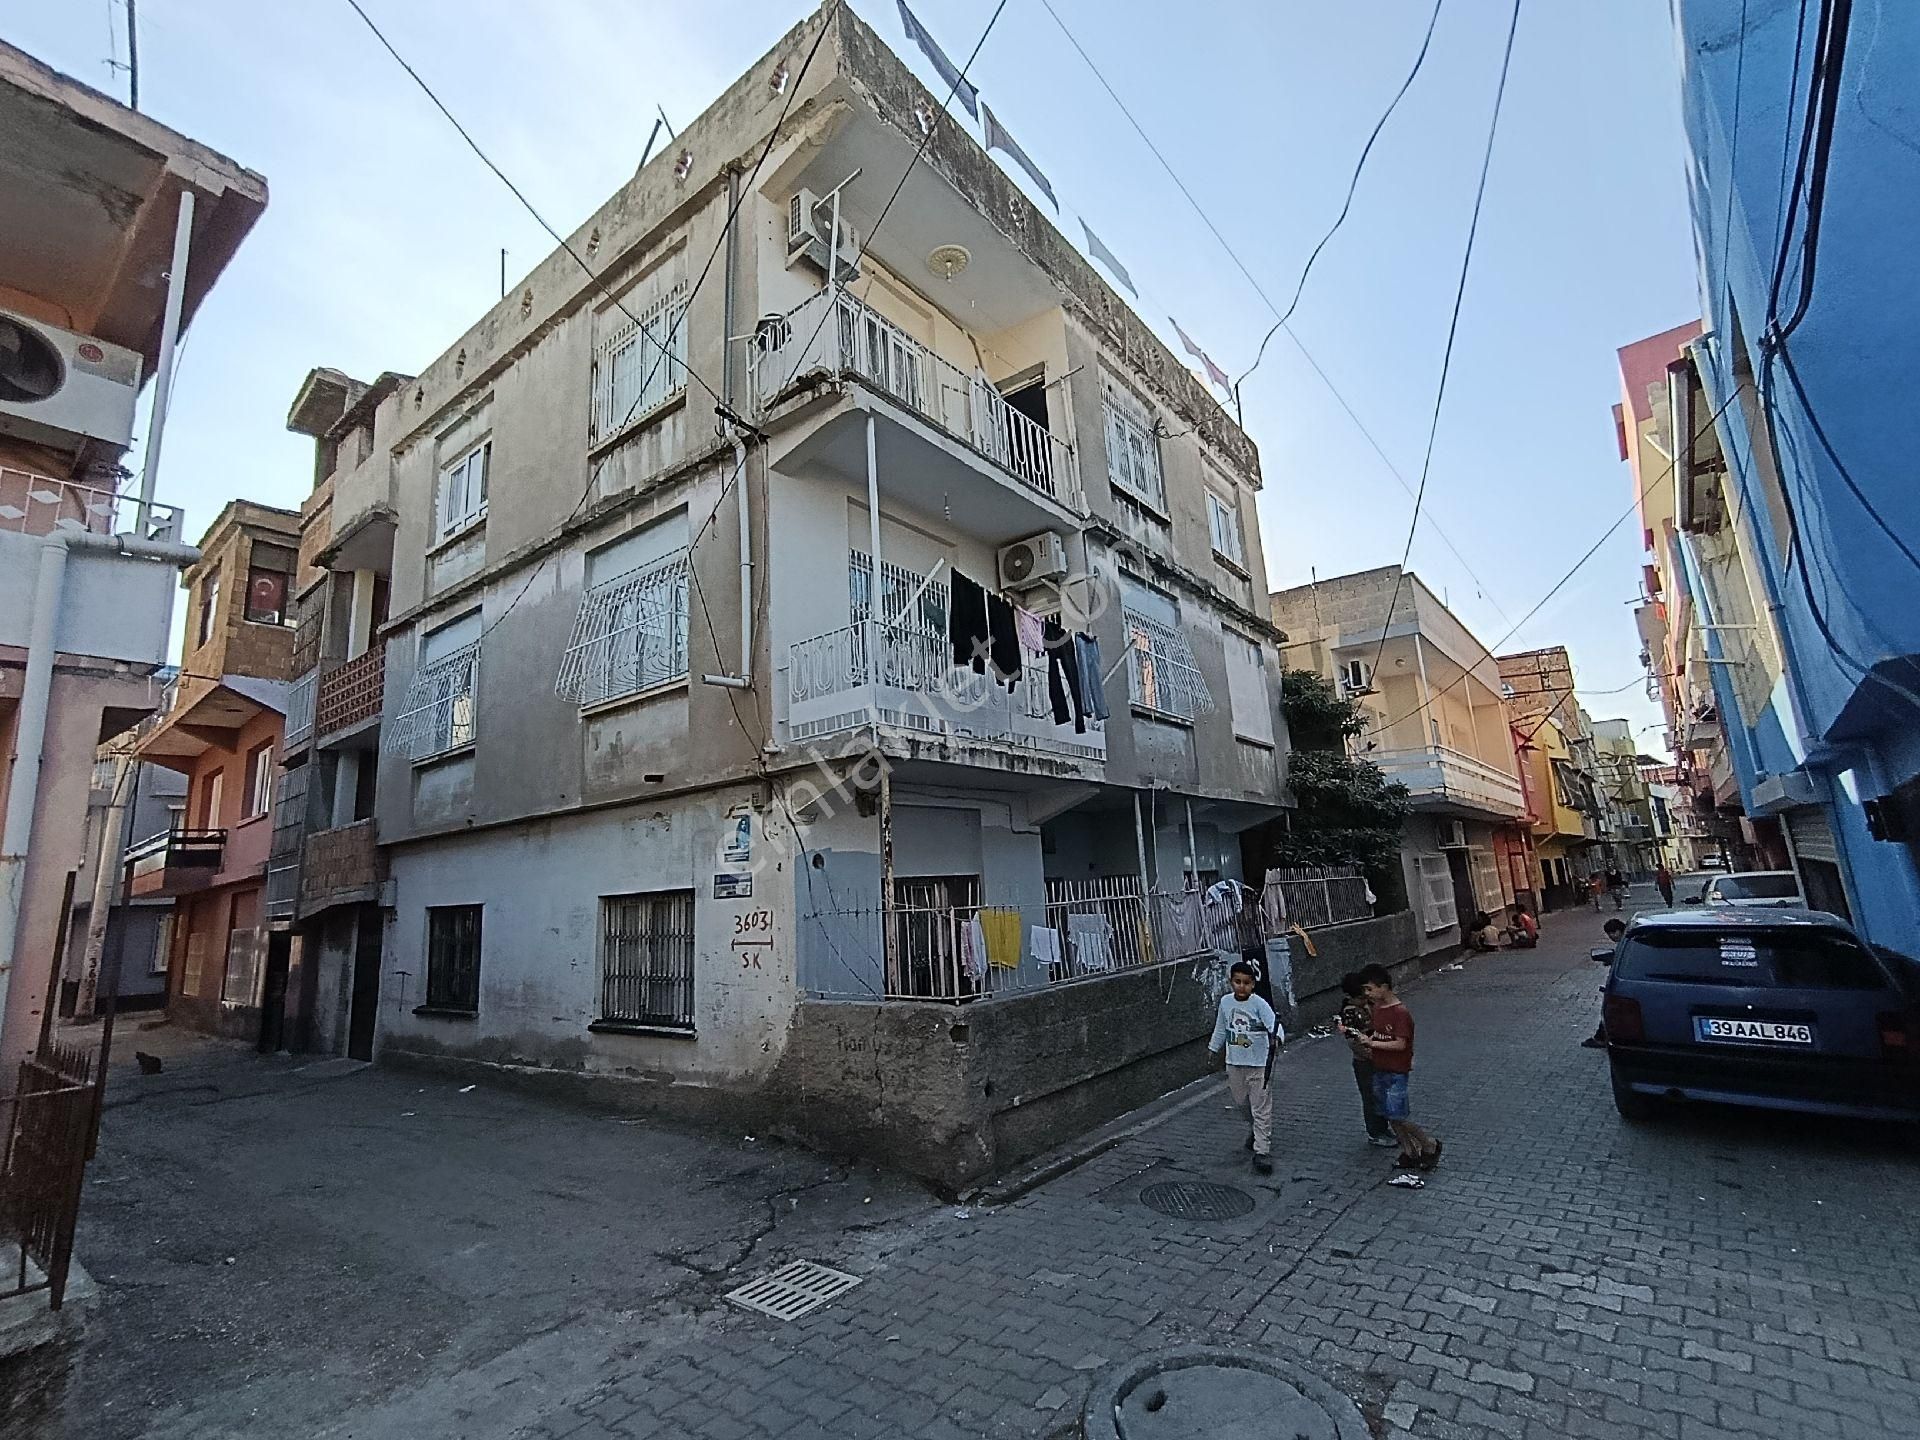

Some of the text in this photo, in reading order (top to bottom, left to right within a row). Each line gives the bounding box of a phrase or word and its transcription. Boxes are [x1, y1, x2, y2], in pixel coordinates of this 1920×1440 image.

[1711, 1021, 1733, 1035] 39
[1735, 1023, 1774, 1038] AAL
[1774, 1025, 1809, 1041] 846
